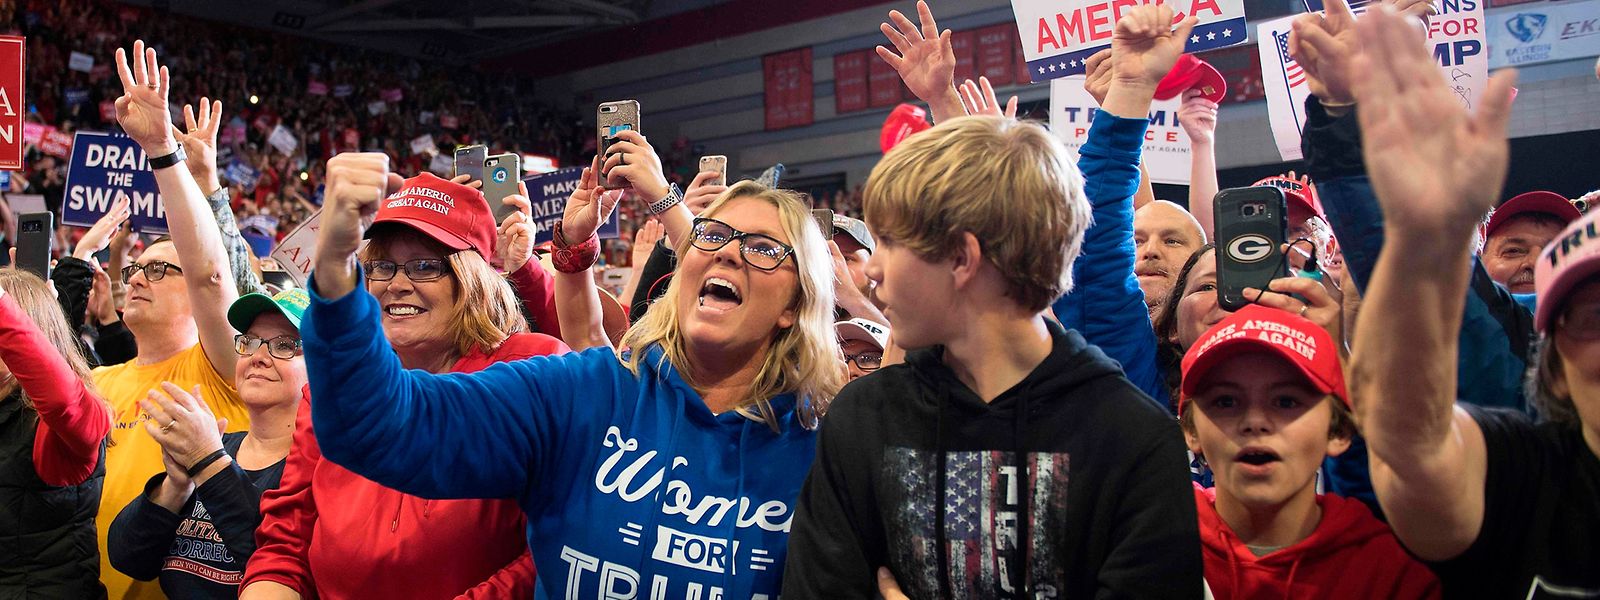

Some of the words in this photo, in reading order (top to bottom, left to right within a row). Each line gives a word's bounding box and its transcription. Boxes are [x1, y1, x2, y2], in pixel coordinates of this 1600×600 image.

[1428, 17, 1478, 39] FOR
[1505, 44, 1551, 57] EASTERN
[1508, 52, 1549, 64] ILLINOIS
[1075, 128, 1177, 142] PCE
[107, 172, 133, 187] THE
[387, 198, 415, 209] GREAT
[414, 199, 449, 215] AGAIN
[409, 186, 455, 208] AMERICA
[1242, 319, 1317, 348] AMERICA
[1258, 331, 1316, 360] AGAIN
[170, 537, 236, 563] CORREC
[666, 532, 726, 567] FOR
[168, 559, 184, 568] WHEN
[185, 562, 198, 572] YOU
[199, 567, 212, 577] CAN
[212, 572, 220, 580] BE
[220, 573, 239, 582] RIGHT
